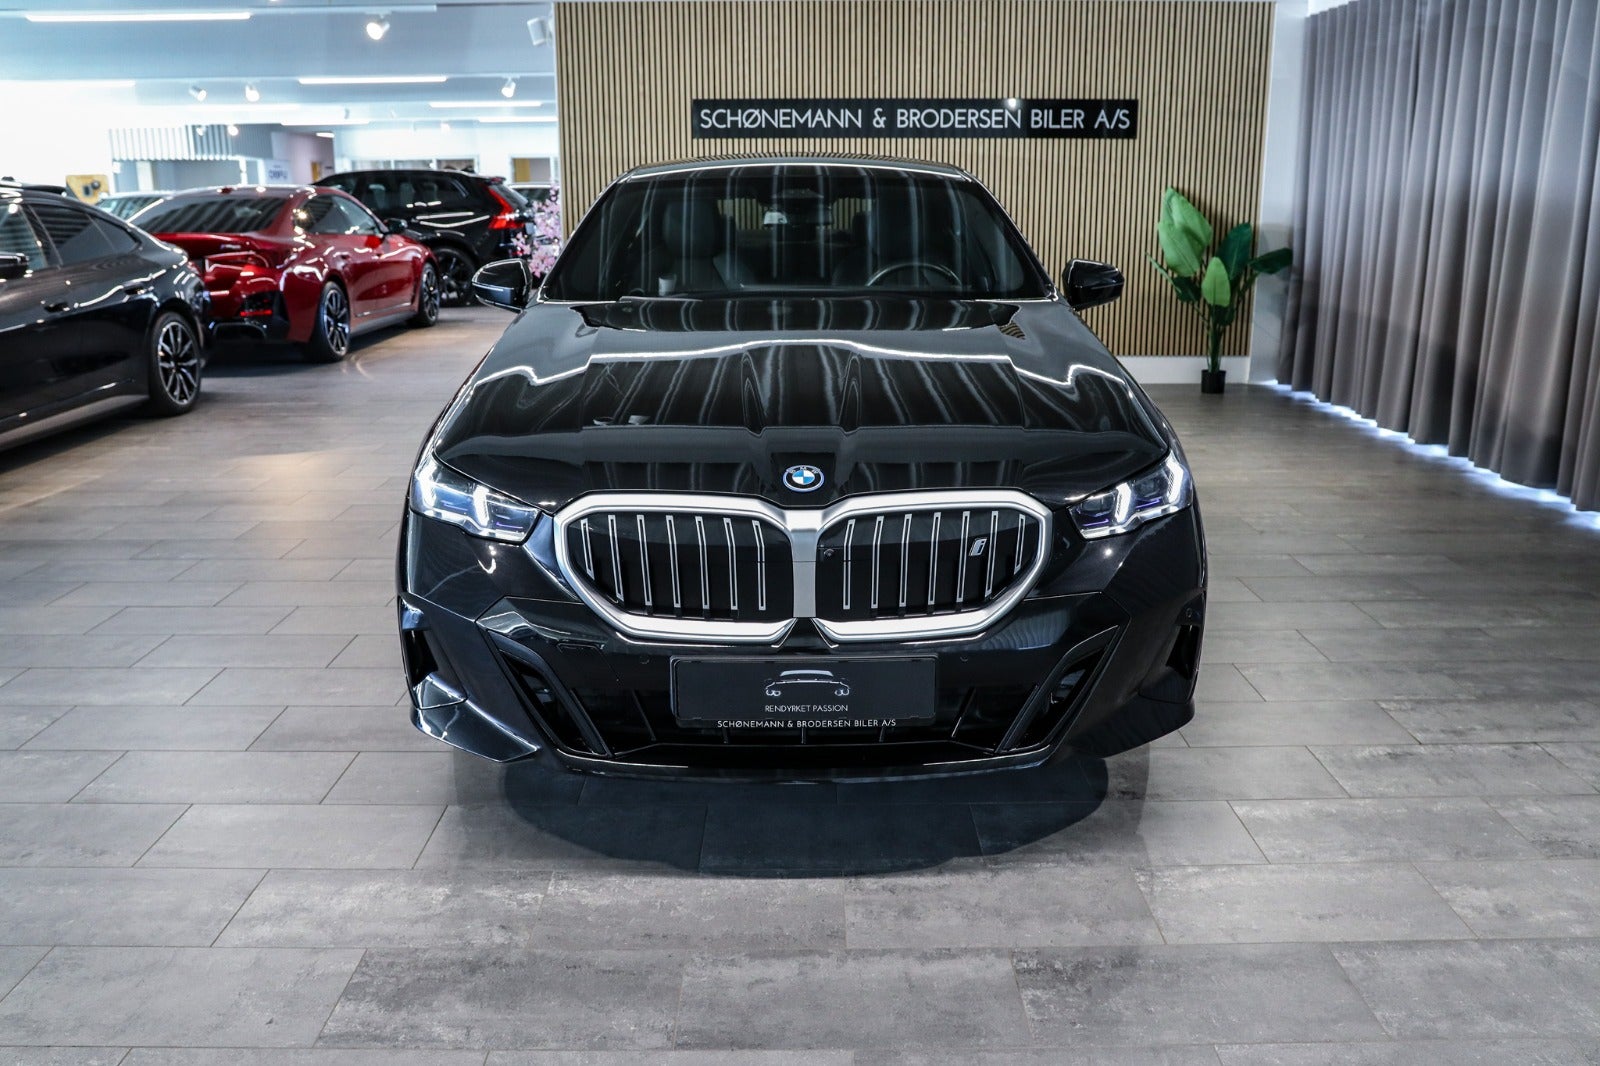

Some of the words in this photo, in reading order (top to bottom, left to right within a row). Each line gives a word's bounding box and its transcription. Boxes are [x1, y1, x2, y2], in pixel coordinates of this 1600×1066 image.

[700, 108, 862, 129] SCHØNEMANN
[872, 107, 886, 129] &
[897, 108, 1022, 129] BRODERSEN
[1030, 108, 1085, 129] BILER
[1094, 108, 1131, 129] A/S
[764, 704, 811, 712] RENDYRKET
[812, 704, 849, 712] PASSION
[717, 720, 785, 728] SCHØNEMANN
[787, 720, 794, 728] &
[796, 720, 850, 728] BRODERSEN
[854, 719, 879, 728] BILER
[881, 718, 897, 728] A/S
